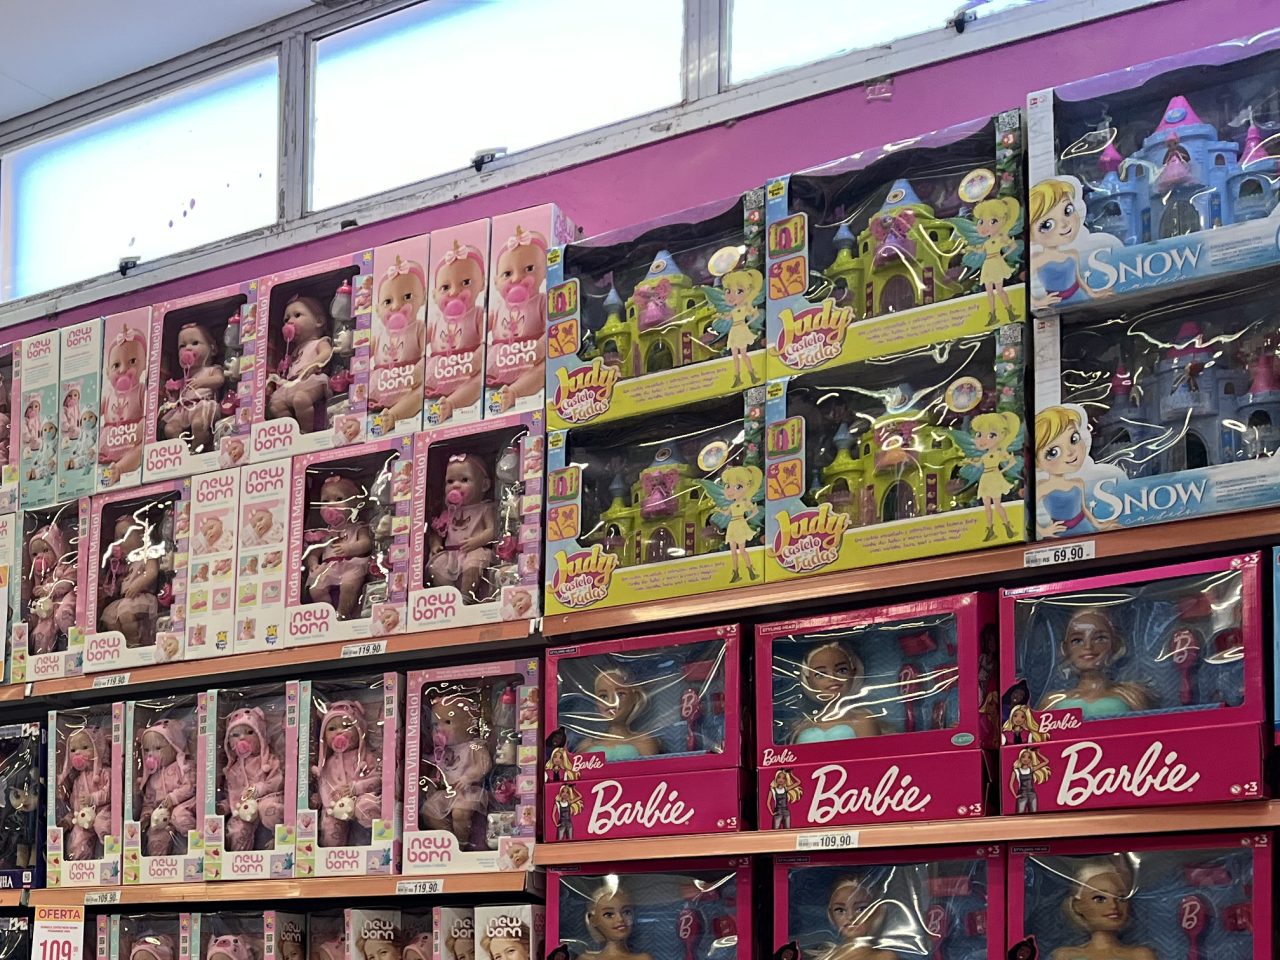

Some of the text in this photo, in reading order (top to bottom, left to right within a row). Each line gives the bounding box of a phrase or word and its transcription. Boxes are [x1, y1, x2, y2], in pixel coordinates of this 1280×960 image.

[770, 298, 854, 356] Judy
[499, 340, 537, 354] new
[785, 333, 824, 356] Castelo
[437, 352, 474, 367] new
[496, 352, 536, 367] born
[798, 343, 841, 367] Fadas
[381, 364, 415, 379] new
[434, 363, 473, 378] born
[377, 375, 414, 391] born
[549, 357, 617, 410] Judy
[560, 390, 594, 411] Castelo
[572, 399, 609, 420] Fadas
[258, 423, 293, 438] new
[149, 443, 183, 458] new
[255, 435, 292, 451] born
[146, 454, 182, 471] born
[200, 476, 234, 490] new
[416, 452, 425, 497] Macio!
[197, 487, 233, 503] born
[295, 475, 303, 517] Macio!
[414, 500, 423, 535] Vinil
[292, 520, 301, 554] Vinil
[767, 503, 851, 557] Judy
[783, 539, 820, 558] Castelo
[795, 548, 838, 571] Fadas
[411, 561, 420, 588] Toda
[547, 544, 617, 594] Judy
[287, 577, 299, 603] Toda
[559, 575, 592, 595] Castelo
[416, 593, 456, 607] new
[571, 584, 606, 605] Fadas
[292, 608, 329, 623] new
[413, 605, 456, 621] born
[289, 620, 329, 636] born
[1039, 712, 1082, 733] Barbie
[572, 755, 604, 771] Barbie
[763, 749, 797, 766] Barbie
[1057, 741, 1200, 806] Barbie
[807, 765, 931, 823] Barbie
[587, 780, 695, 834] Barbie
[411, 837, 452, 850] new
[329, 851, 359, 860] new
[407, 847, 451, 862] born
[326, 858, 358, 869] born
[38, 909, 81, 920] OFERTA
[489, 917, 521, 927] new
[487, 925, 521, 936] born
